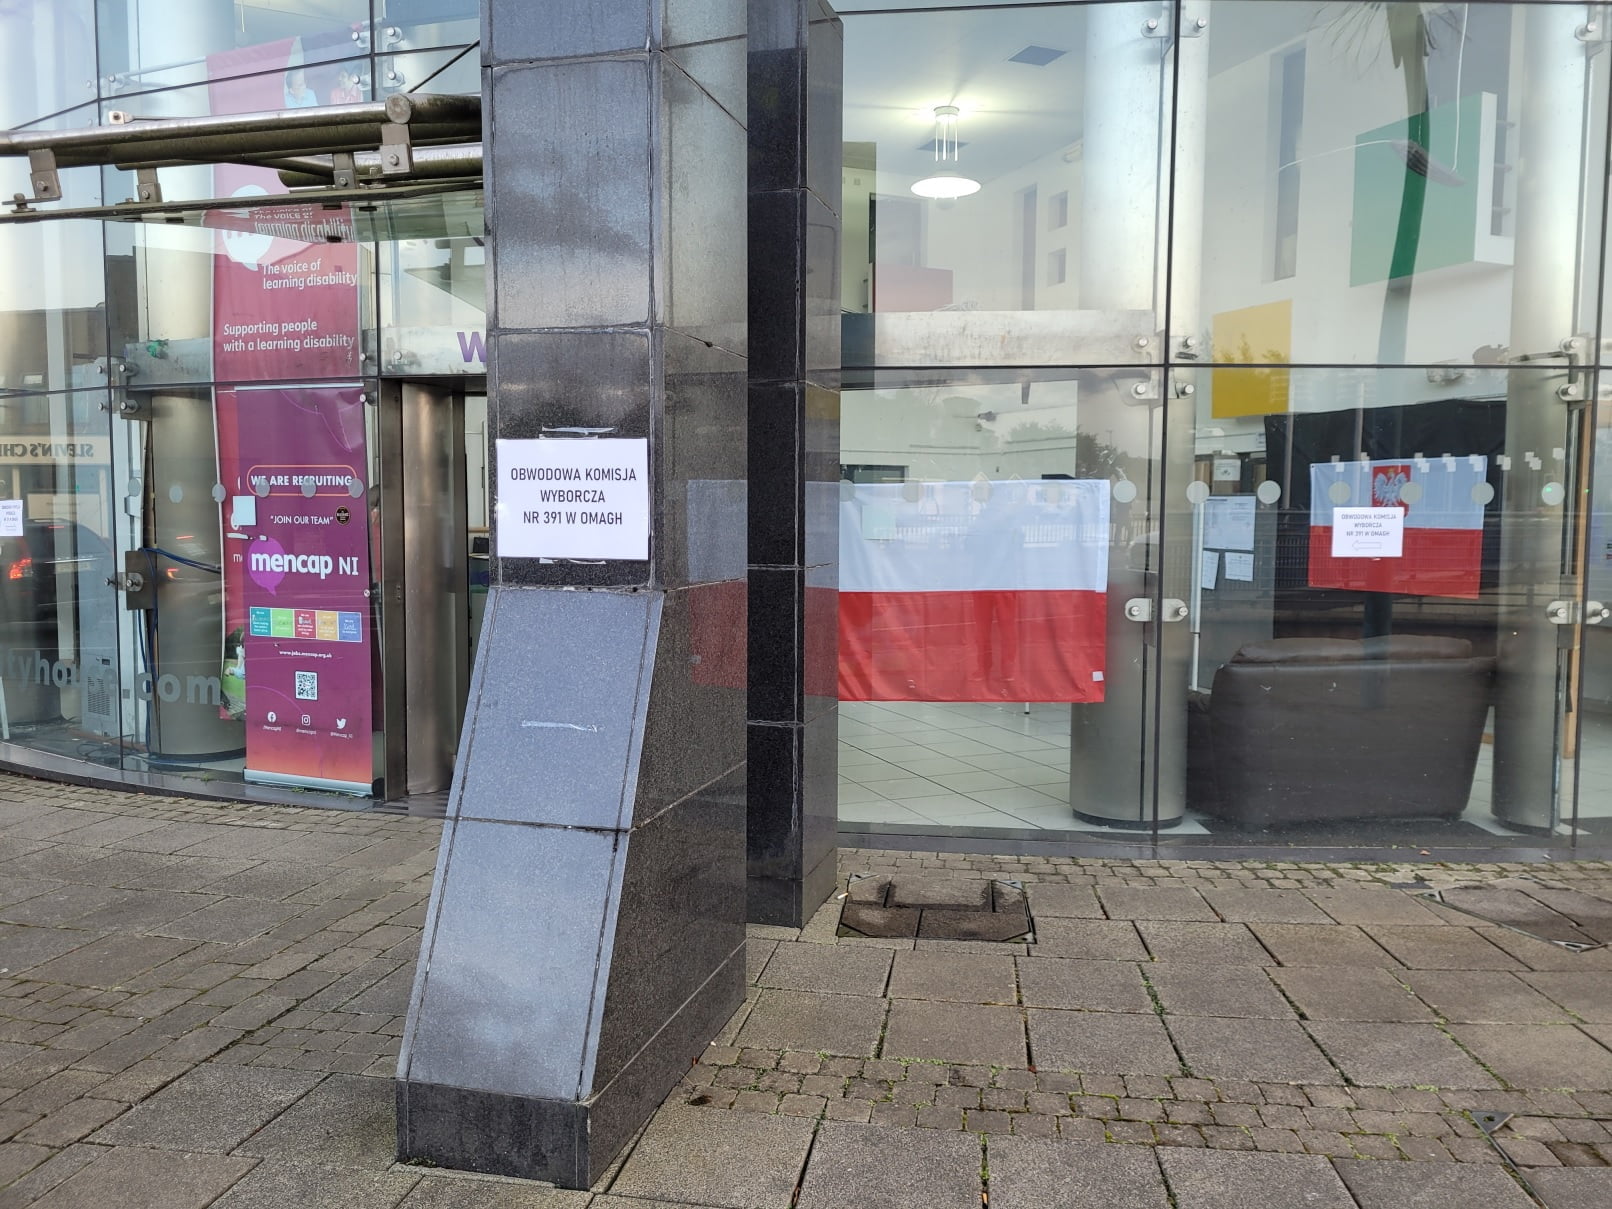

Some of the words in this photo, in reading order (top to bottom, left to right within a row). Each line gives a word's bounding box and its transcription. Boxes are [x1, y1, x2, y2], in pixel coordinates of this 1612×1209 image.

[263, 263, 280, 275] The
[281, 260, 308, 274] voice
[310, 258, 322, 271] of
[263, 275, 305, 290] learning
[307, 271, 358, 287] disability
[223, 320, 279, 337] Supporting
[282, 318, 318, 334] people
[223, 340, 245, 352] with
[247, 342, 255, 350] a
[257, 337, 300, 352] learning
[303, 335, 355, 349] disability
[250, 475, 267, 486] WE
[269, 475, 290, 486] ARE
[292, 475, 353, 486] RECRUITING
[510, 467, 582, 481] OBWODOWA
[585, 467, 637, 481] KOMISJA
[540, 489, 606, 503] WYBORCZA
[293, 515, 309, 525] OUR
[523, 511, 539, 524] NR
[543, 511, 562, 524] 391
[565, 511, 577, 524] W
[580, 511, 623, 525] OMAGH
[251, 553, 333, 580] mencap
[338, 556, 359, 576] NI
[0, 649, 223, 706] tyhouse.com
